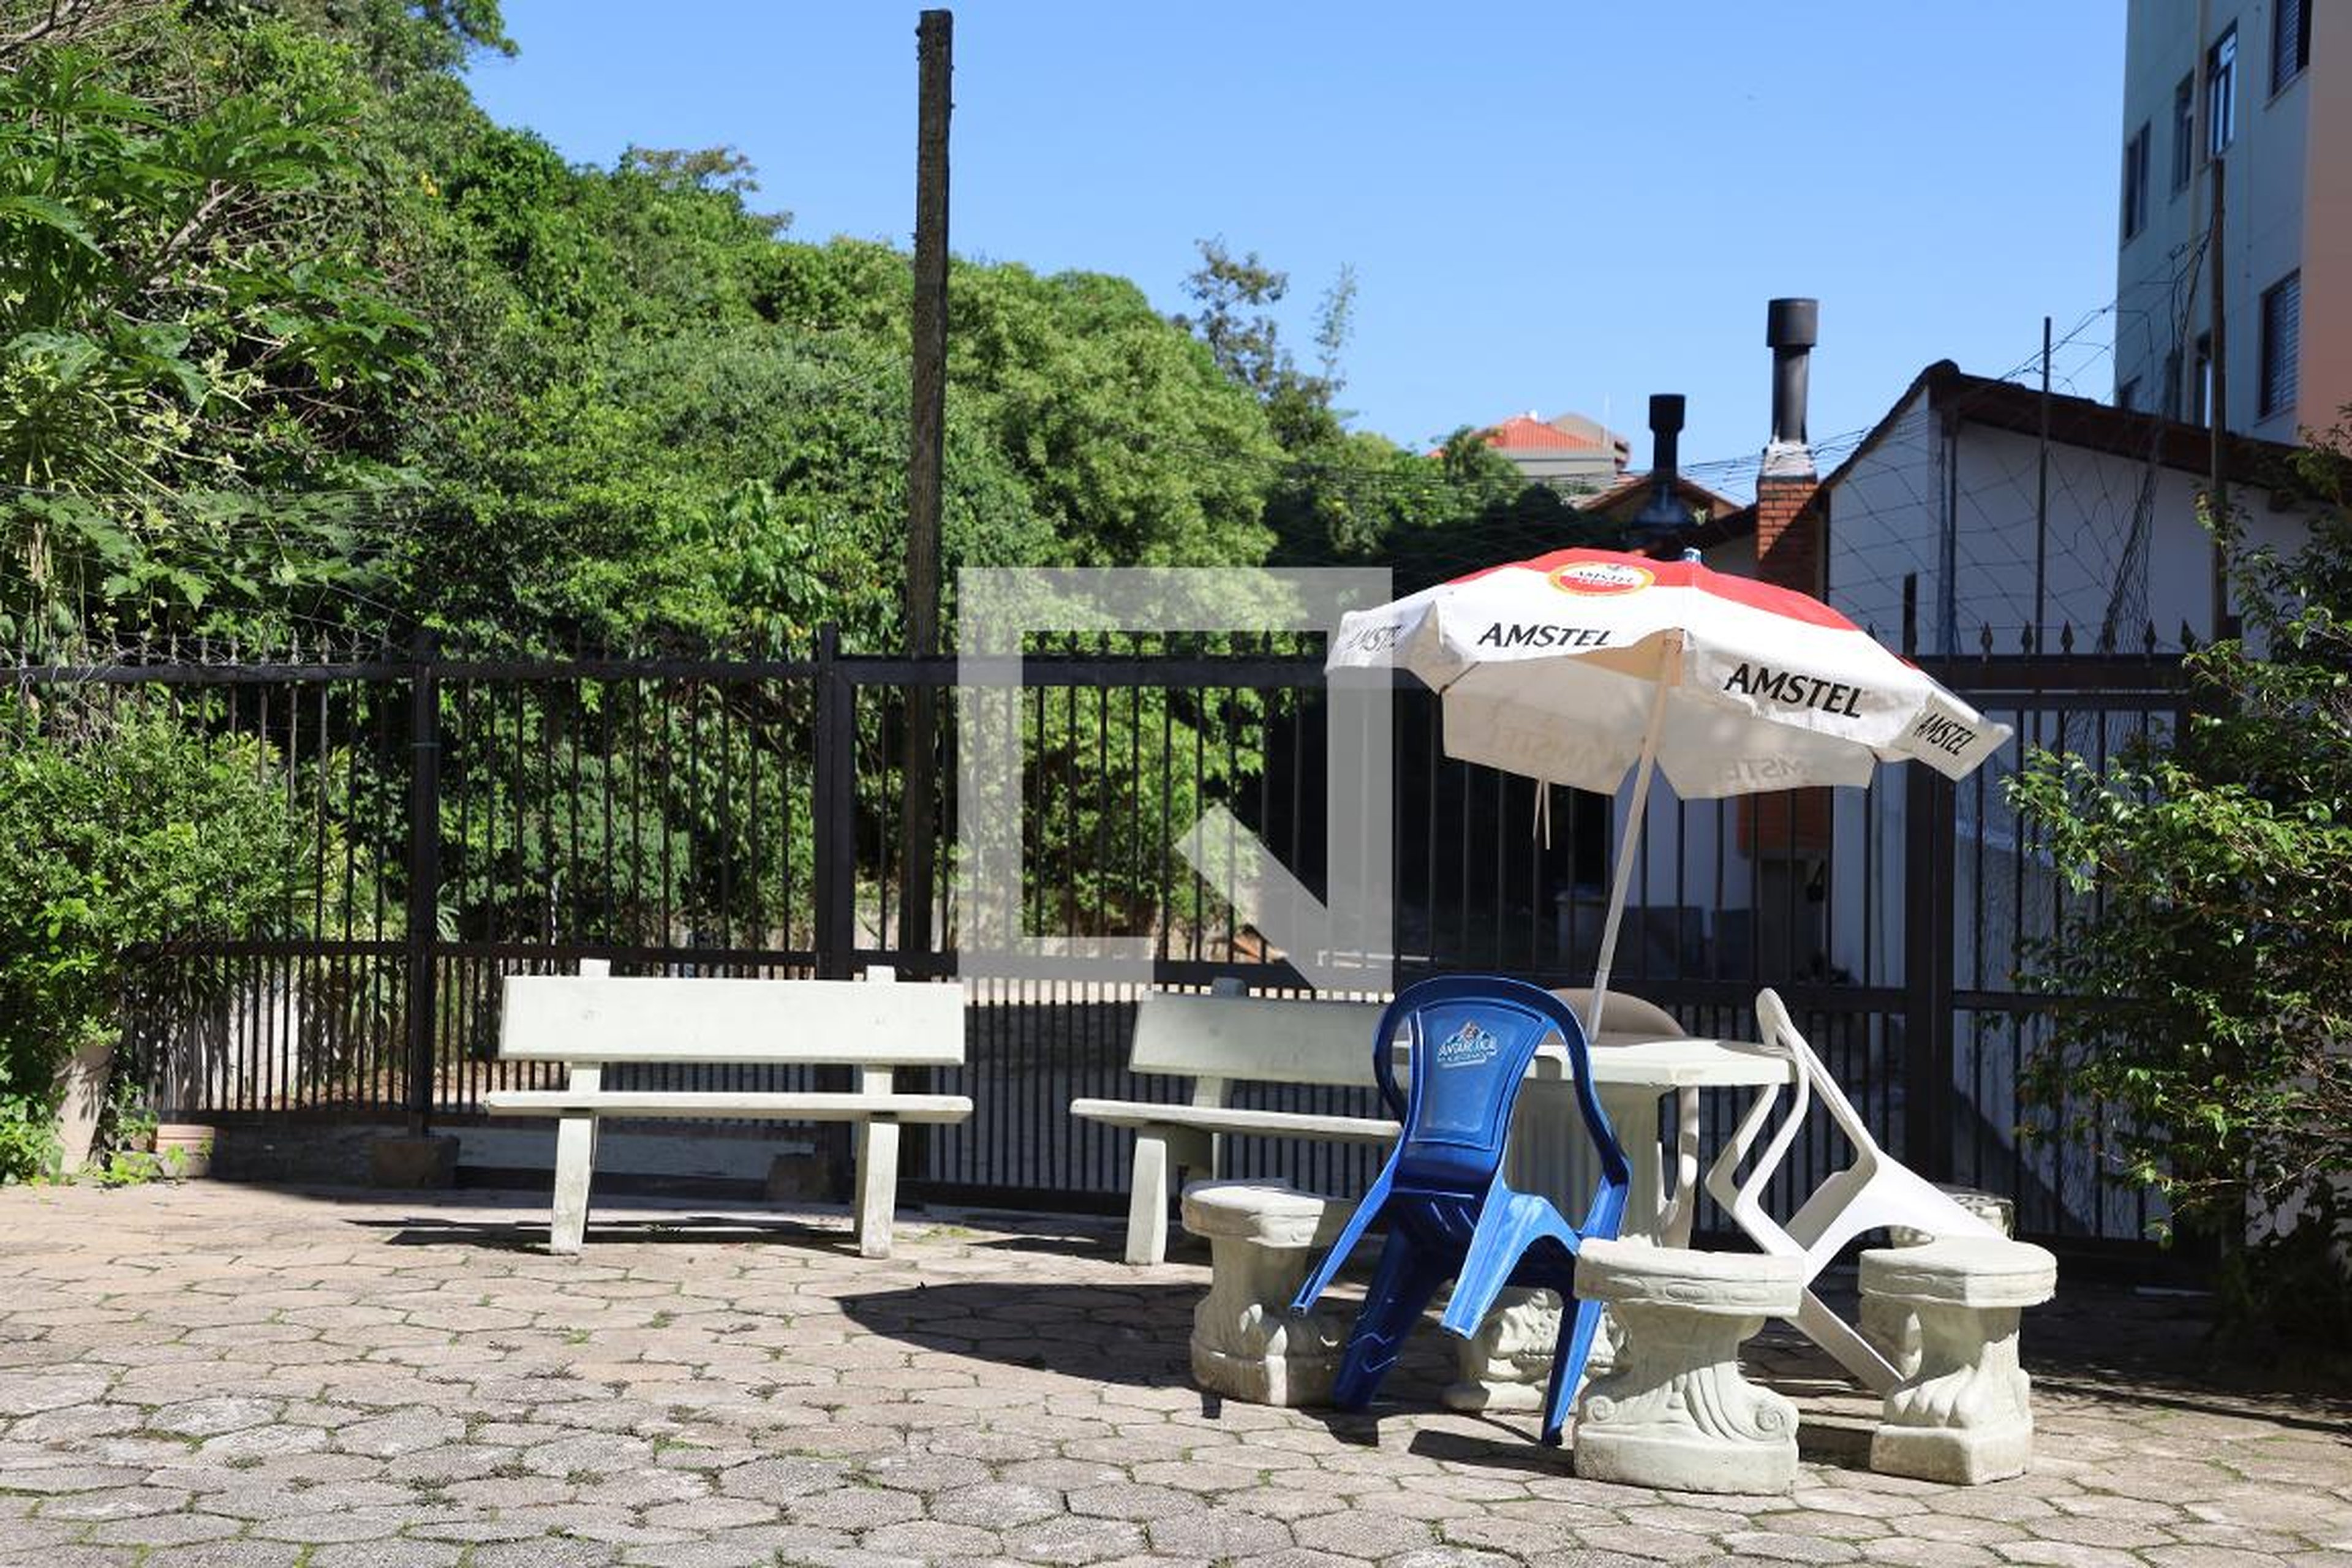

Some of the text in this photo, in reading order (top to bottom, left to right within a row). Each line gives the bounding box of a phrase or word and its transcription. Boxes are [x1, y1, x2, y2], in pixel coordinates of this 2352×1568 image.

[1477, 622, 1611, 647] AMSTEL
[1723, 663, 1863, 718] AMSTEL
[1912, 713, 1977, 756] AMSTEL
